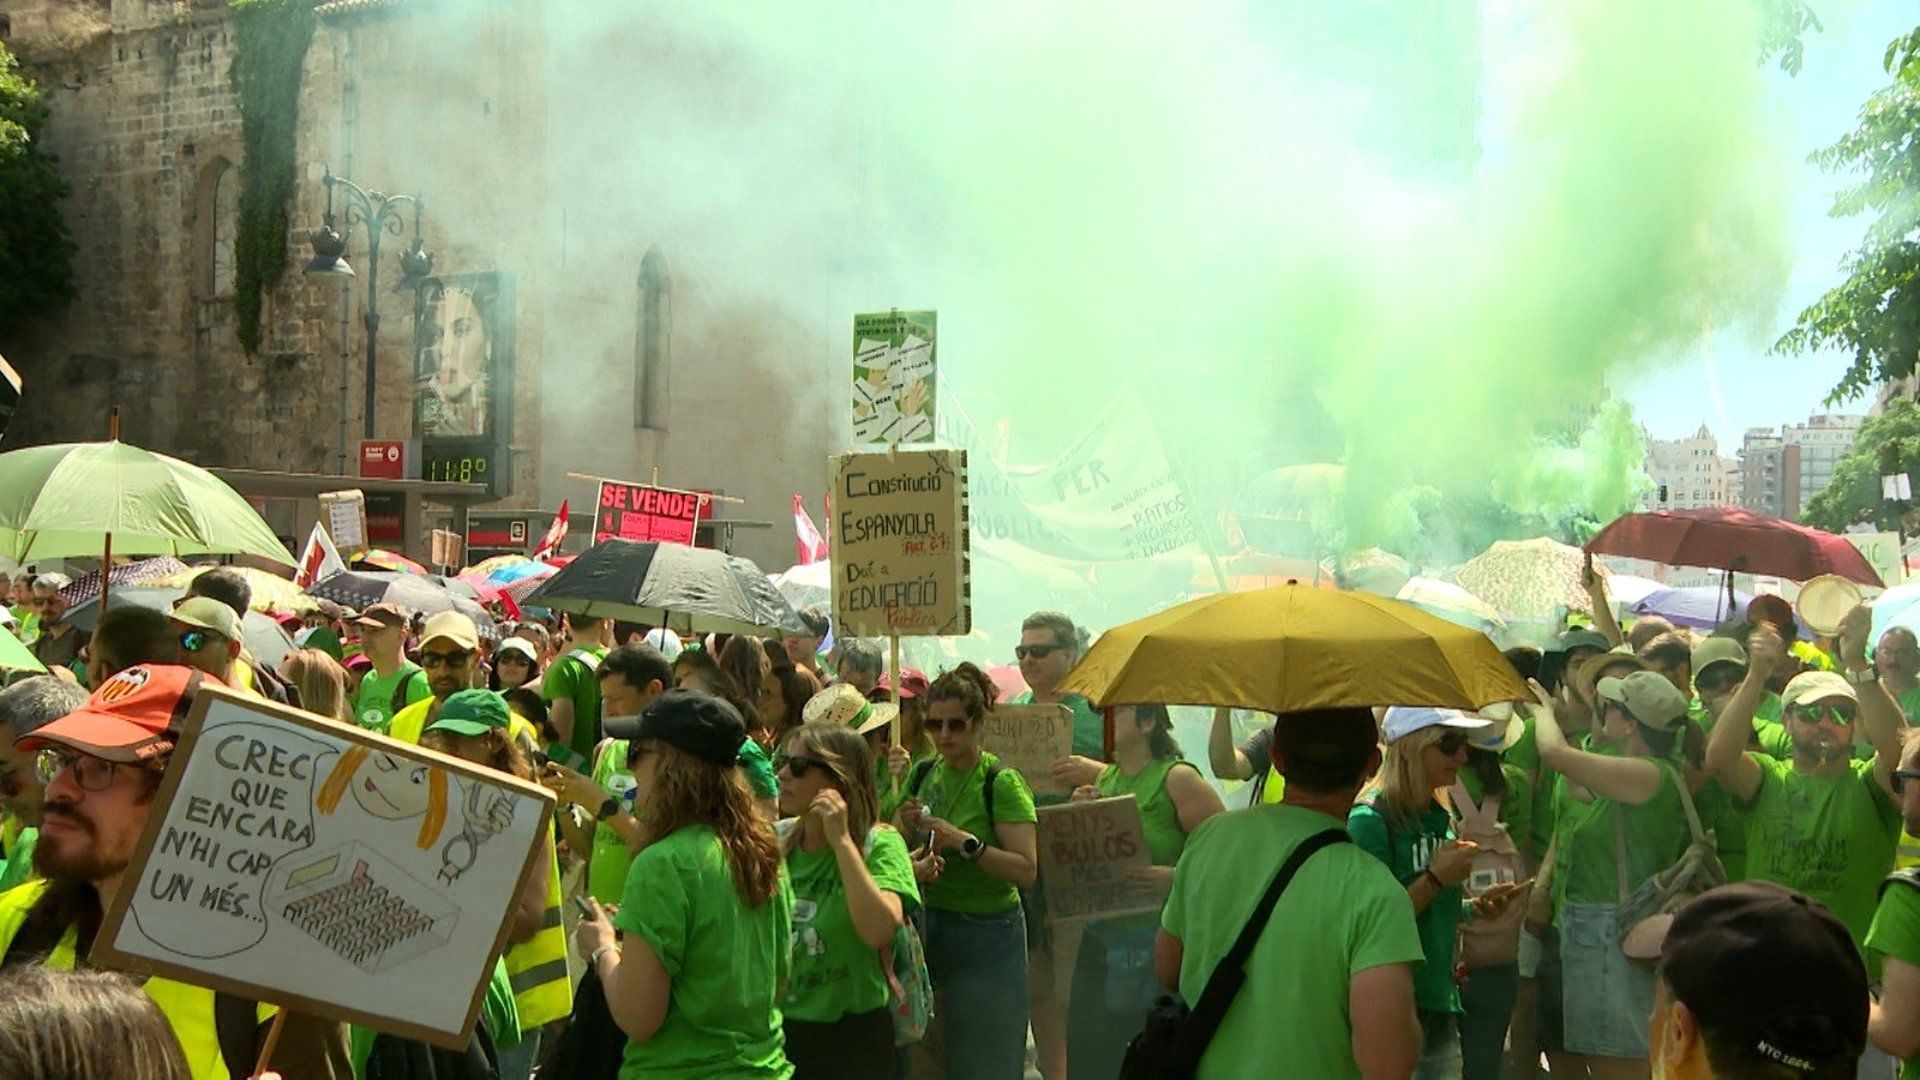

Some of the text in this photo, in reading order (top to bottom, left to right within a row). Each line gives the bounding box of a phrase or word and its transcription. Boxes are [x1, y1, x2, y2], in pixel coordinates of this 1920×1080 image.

[601, 484, 697, 518] SE VENDE
[841, 511, 935, 545] ESPANYOLA
[215, 734, 312, 780] CREC
[230, 777, 288, 811] QUE
[185, 795, 314, 844] ENCARA
[160, 827, 271, 876] N'HI CAP
[1050, 830, 1139, 865] BULOS
[150, 869, 194, 903] UN
[1757, 1039, 1782, 1060] NYC
